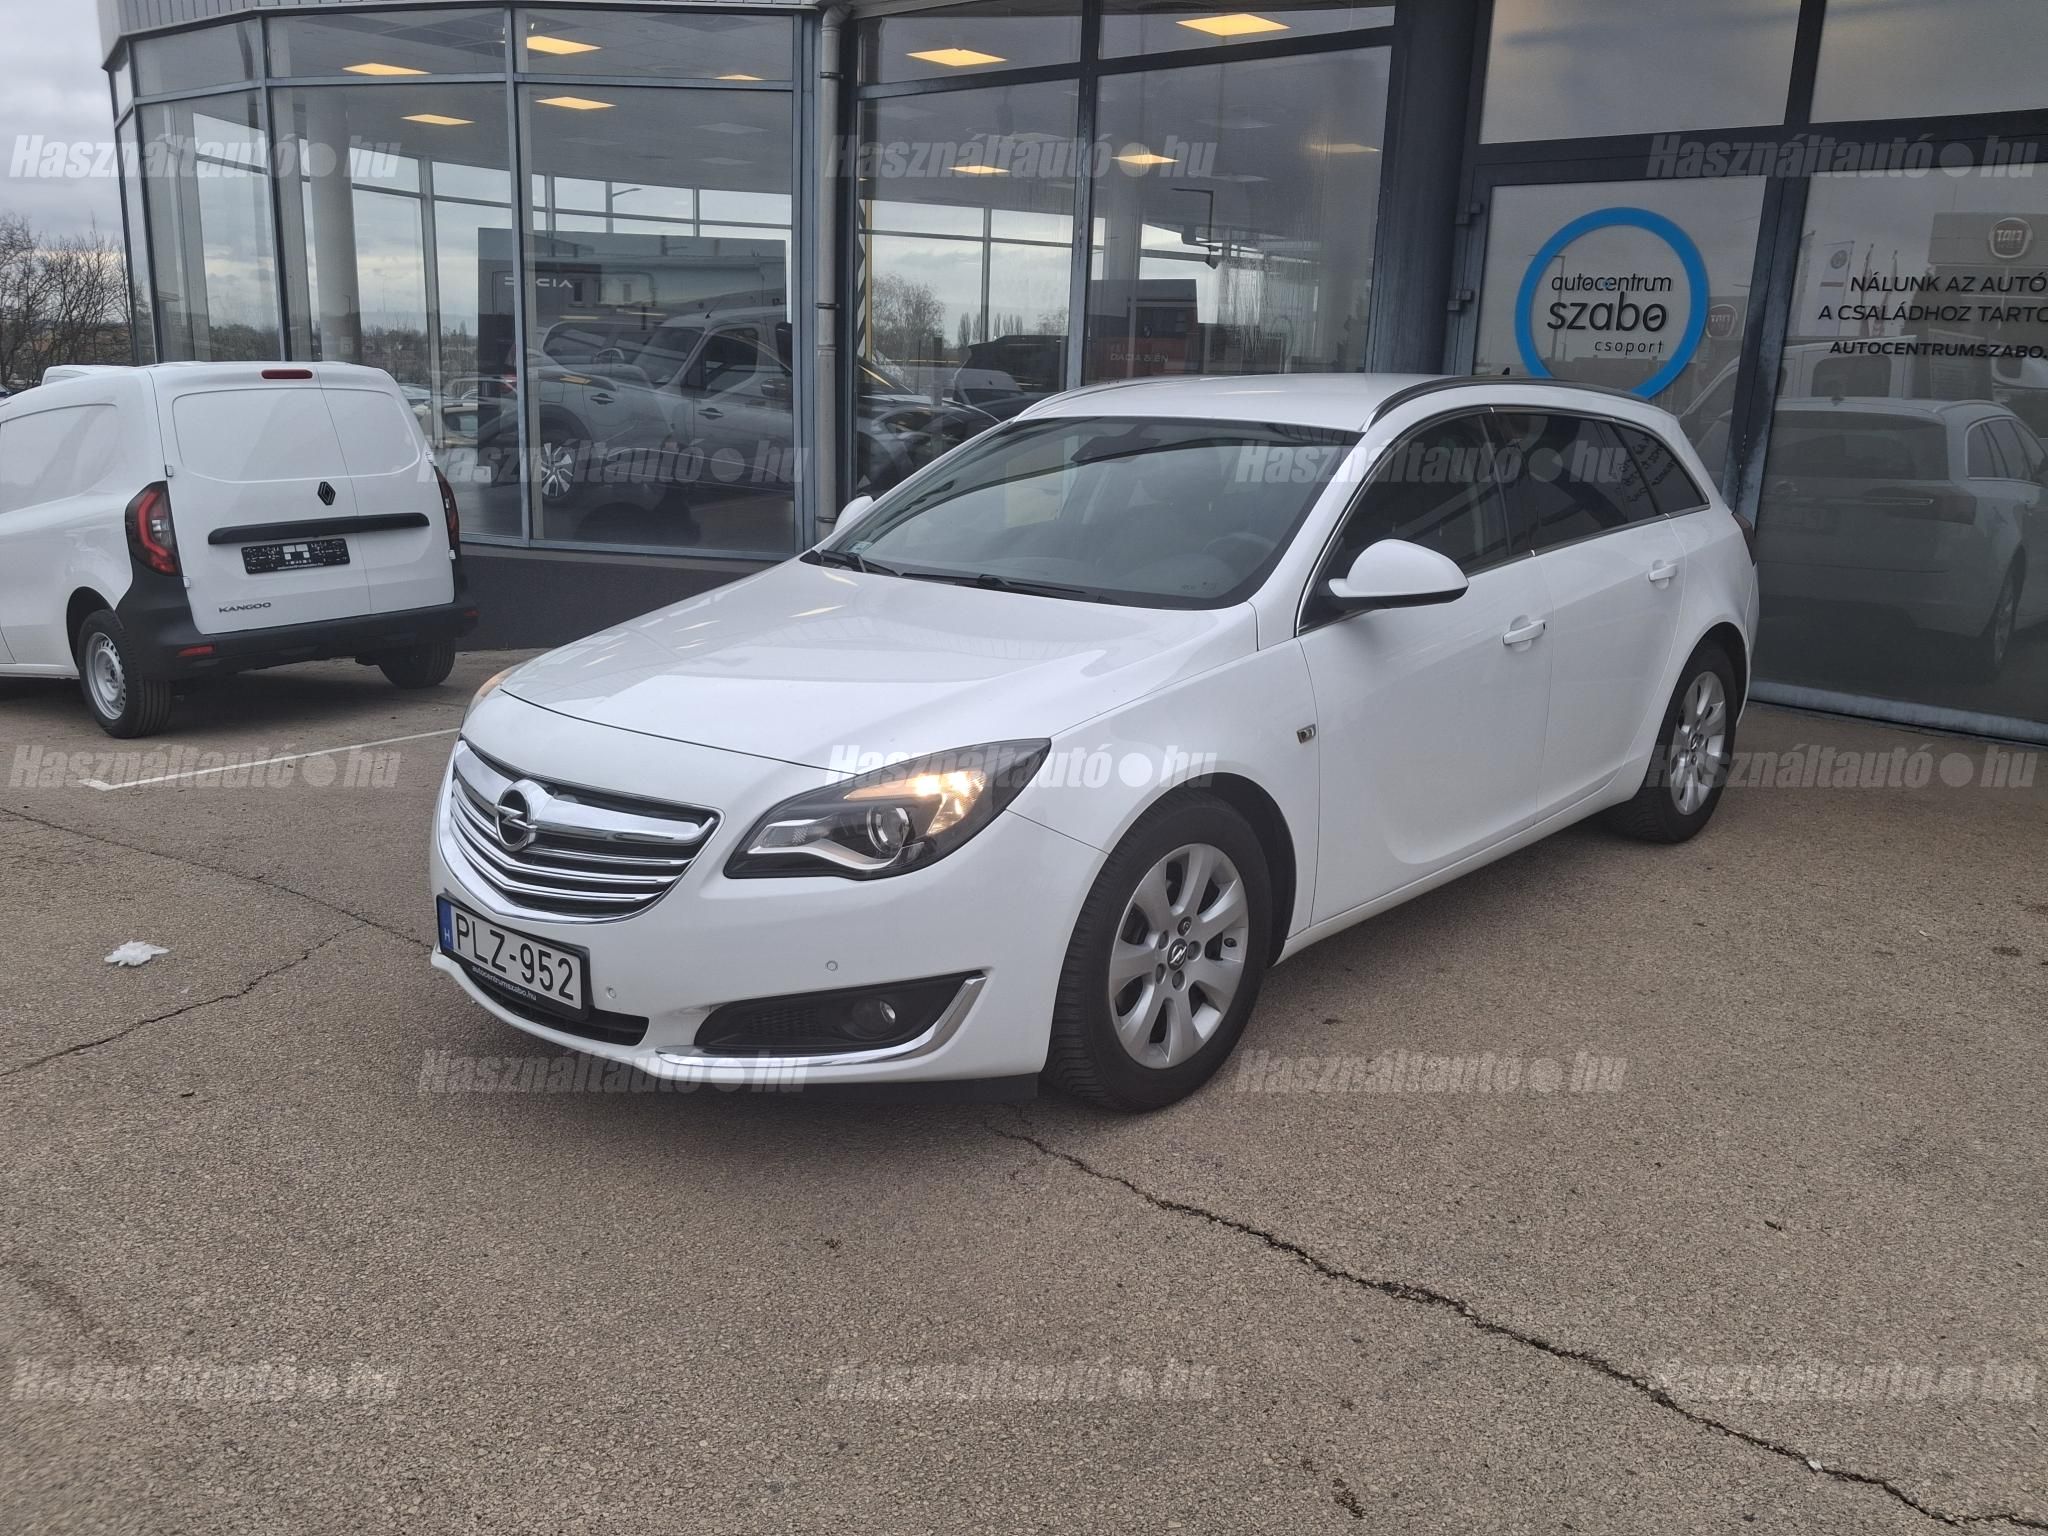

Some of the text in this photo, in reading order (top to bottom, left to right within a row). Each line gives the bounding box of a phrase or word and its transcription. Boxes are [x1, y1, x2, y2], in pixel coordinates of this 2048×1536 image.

[1551, 273, 1672, 292] autocentrum
[1850, 271, 2047, 293] NÁLUNK AZ AUTÓ
[1818, 305, 1833, 320] A
[1838, 301, 1971, 321] CSALÁDHOZ
[1594, 340, 1664, 355] csoport
[219, 602, 272, 613] KANGOO
[455, 912, 574, 1001] PLZ-952
